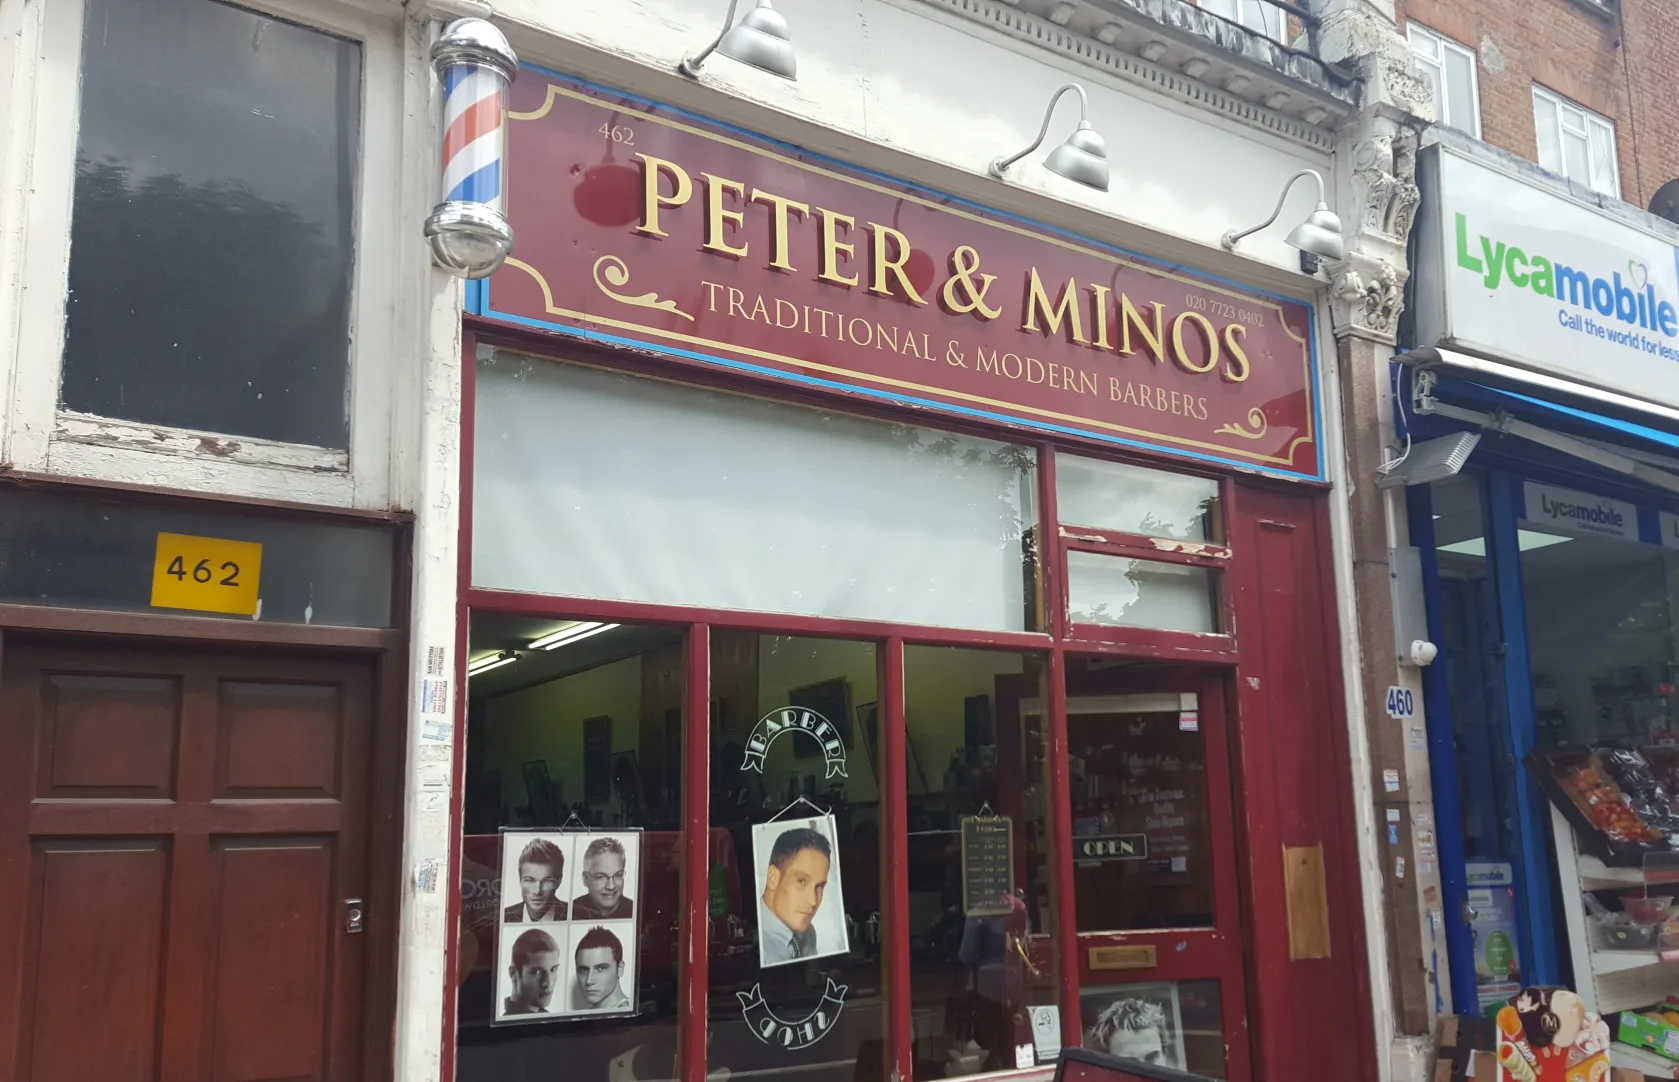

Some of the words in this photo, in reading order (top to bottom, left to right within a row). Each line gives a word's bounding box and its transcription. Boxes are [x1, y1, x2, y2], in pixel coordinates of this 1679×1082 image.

[598, 121, 635, 146] 462
[634, 152, 928, 306] PETER
[943, 245, 1002, 320] &
[1022, 266, 1250, 383] MINOS
[1455, 212, 1678, 338] Lycamobile
[1185, 293, 1206, 311] 020
[1210, 300, 1236, 319] 7723
[1238, 308, 1264, 327] 0402
[701, 280, 937, 362] TRADITIONAL
[946, 340, 968, 369] &
[975, 345, 1099, 397] MODERN
[1109, 376, 1208, 421] BARBERS
[1558, 309, 1582, 332] Call
[1585, 318, 1605, 339] the
[1606, 328, 1640, 349] world
[1641, 336, 1658, 355] for
[1659, 341, 1679, 362] less
[1541, 493, 1624, 528] Lycamobile
[167, 555, 240, 587] 462
[1388, 689, 1413, 716] 460
[750, 710, 842, 759] BARBER
[1083, 839, 1134, 857] OPEN
